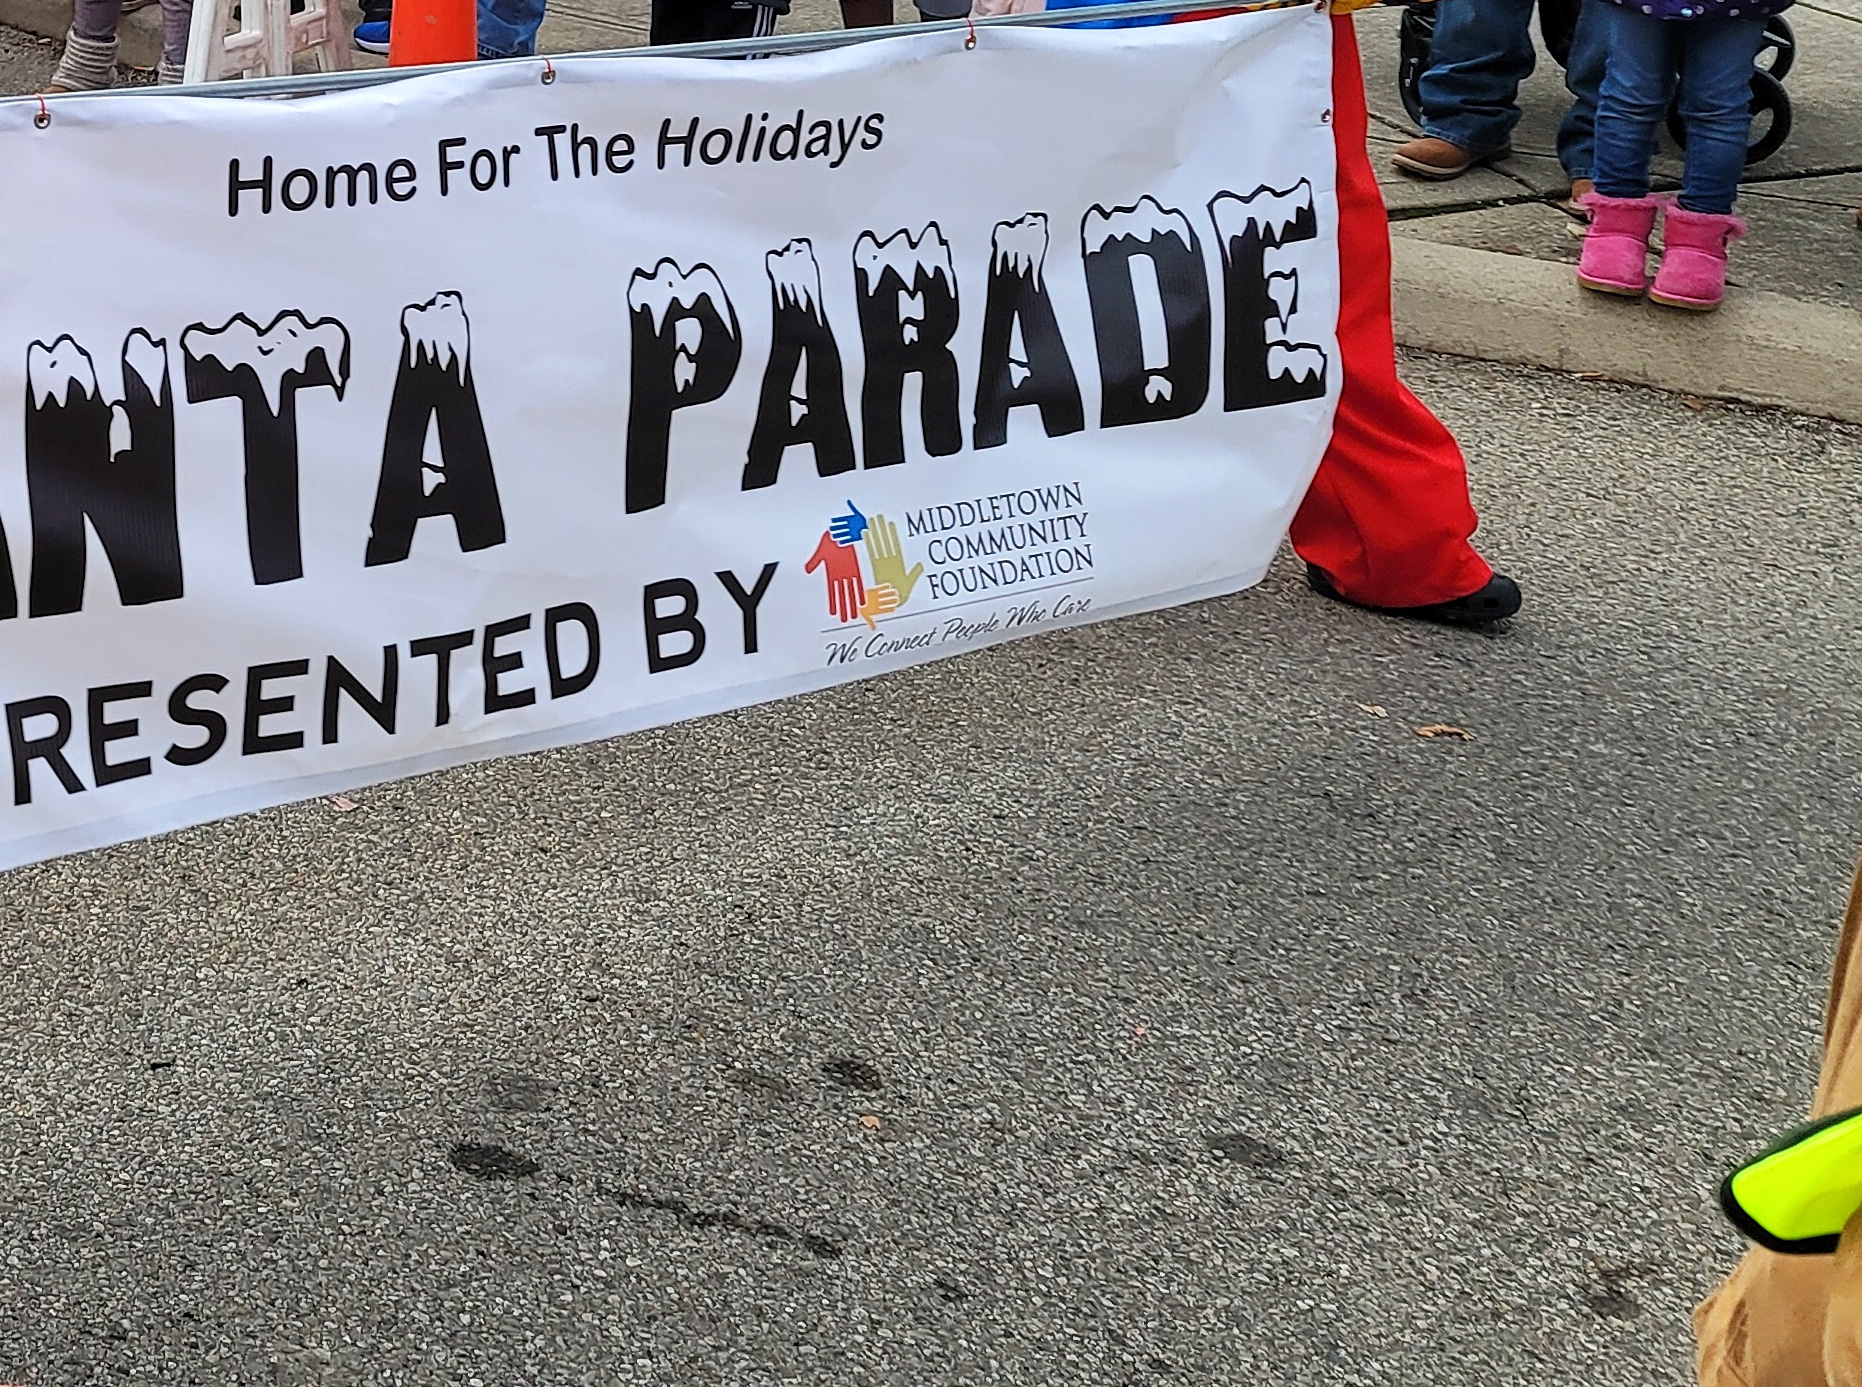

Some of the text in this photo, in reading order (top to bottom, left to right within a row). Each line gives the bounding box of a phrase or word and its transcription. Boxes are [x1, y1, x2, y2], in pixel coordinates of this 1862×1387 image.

[228, 109, 885, 217] Home For The Holidays
[625, 176, 1328, 515] PARADE
[906, 482, 1083, 537] MIDDLETOWN
[928, 512, 1089, 565] COMMUNITY
[927, 544, 1094, 600] FOUNDATION
[643, 561, 779, 676] BY
[825, 595, 1092, 666] We Connect People Who Care
